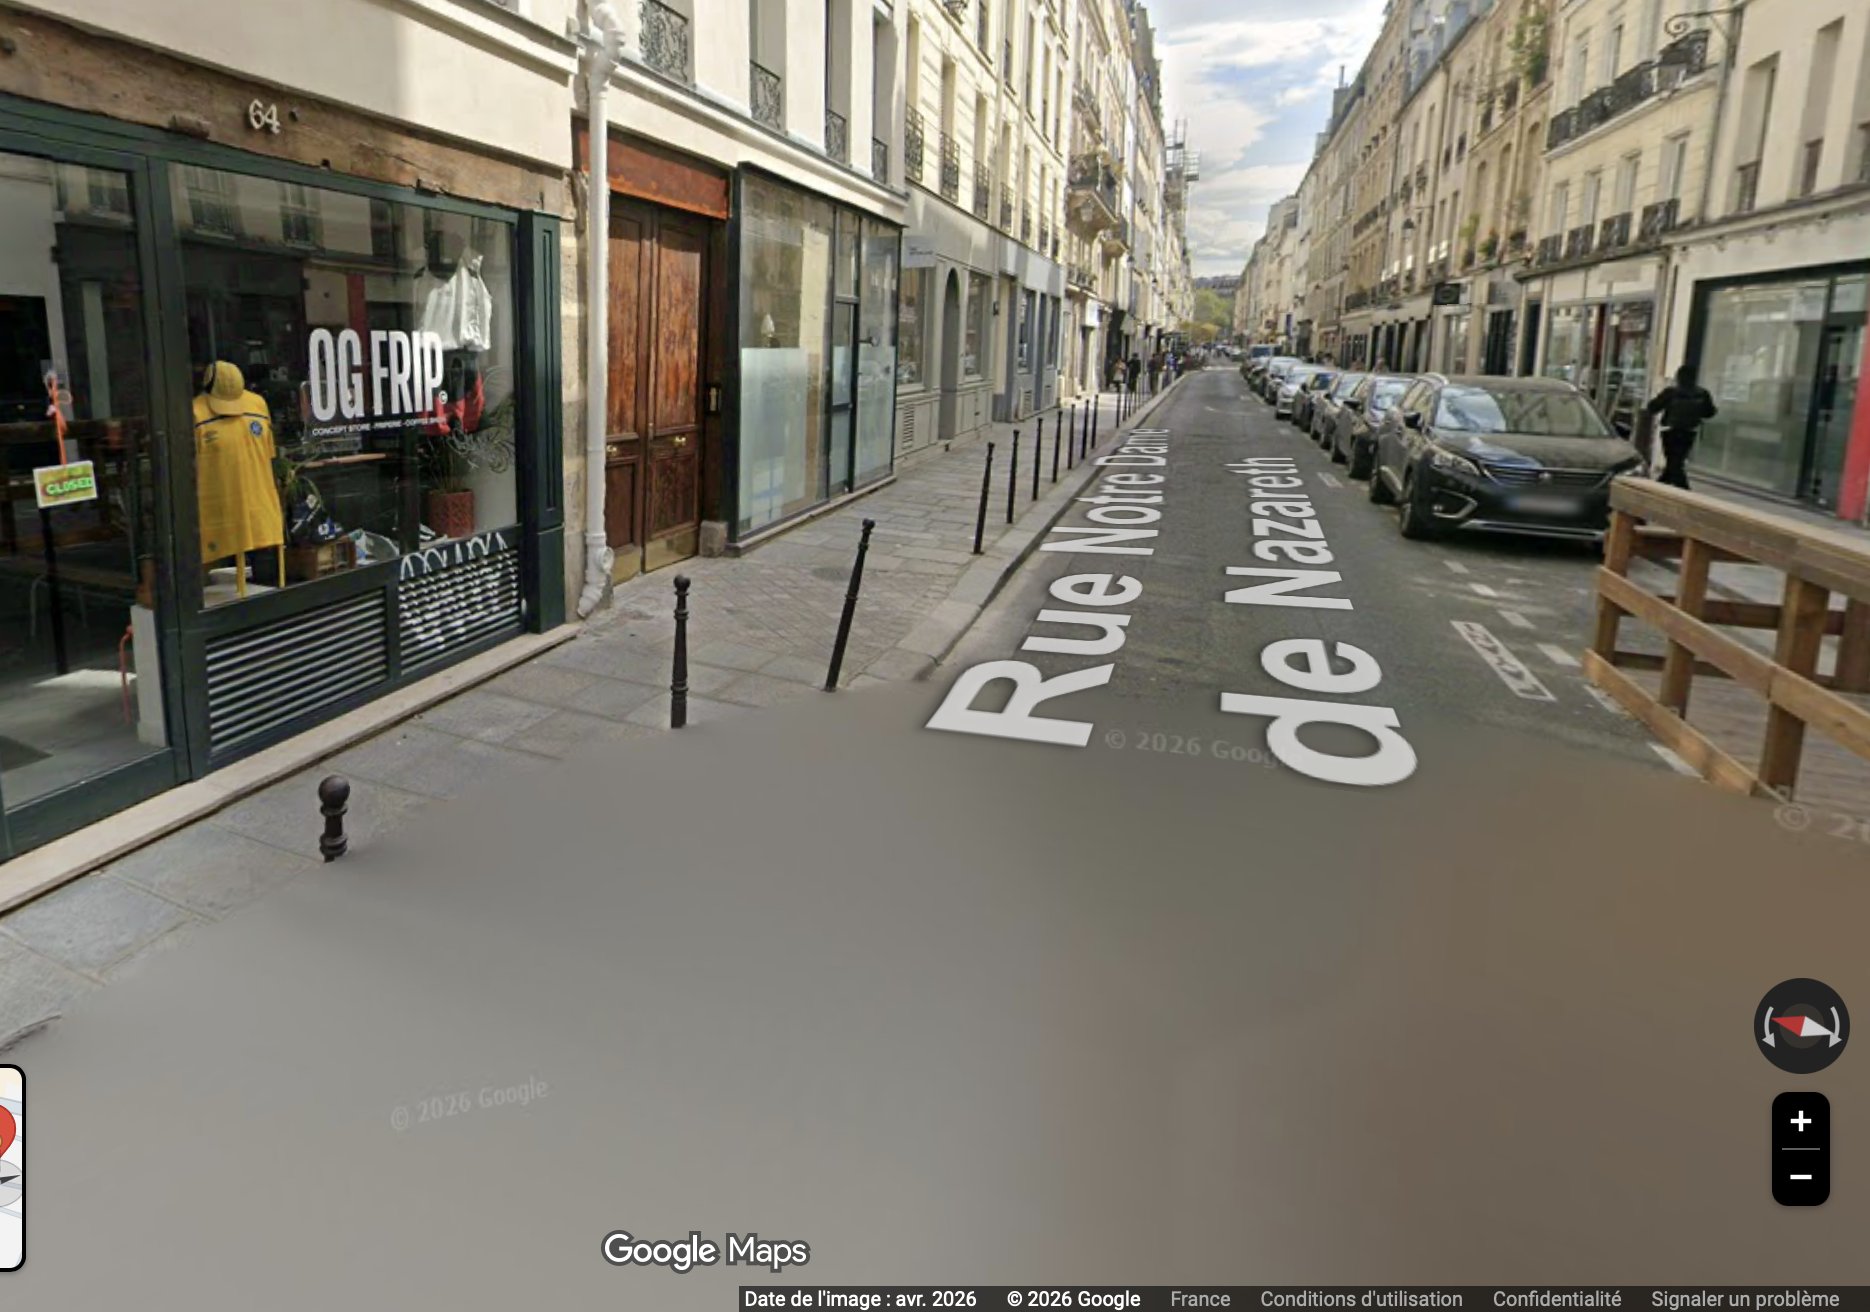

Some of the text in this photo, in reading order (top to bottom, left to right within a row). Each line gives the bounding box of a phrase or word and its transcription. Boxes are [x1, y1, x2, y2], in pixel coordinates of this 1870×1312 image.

[249, 99, 280, 134] 64
[309, 328, 365, 421] OG
[312, 426, 348, 437] CONCEPT
[349, 422, 371, 433] STORE
